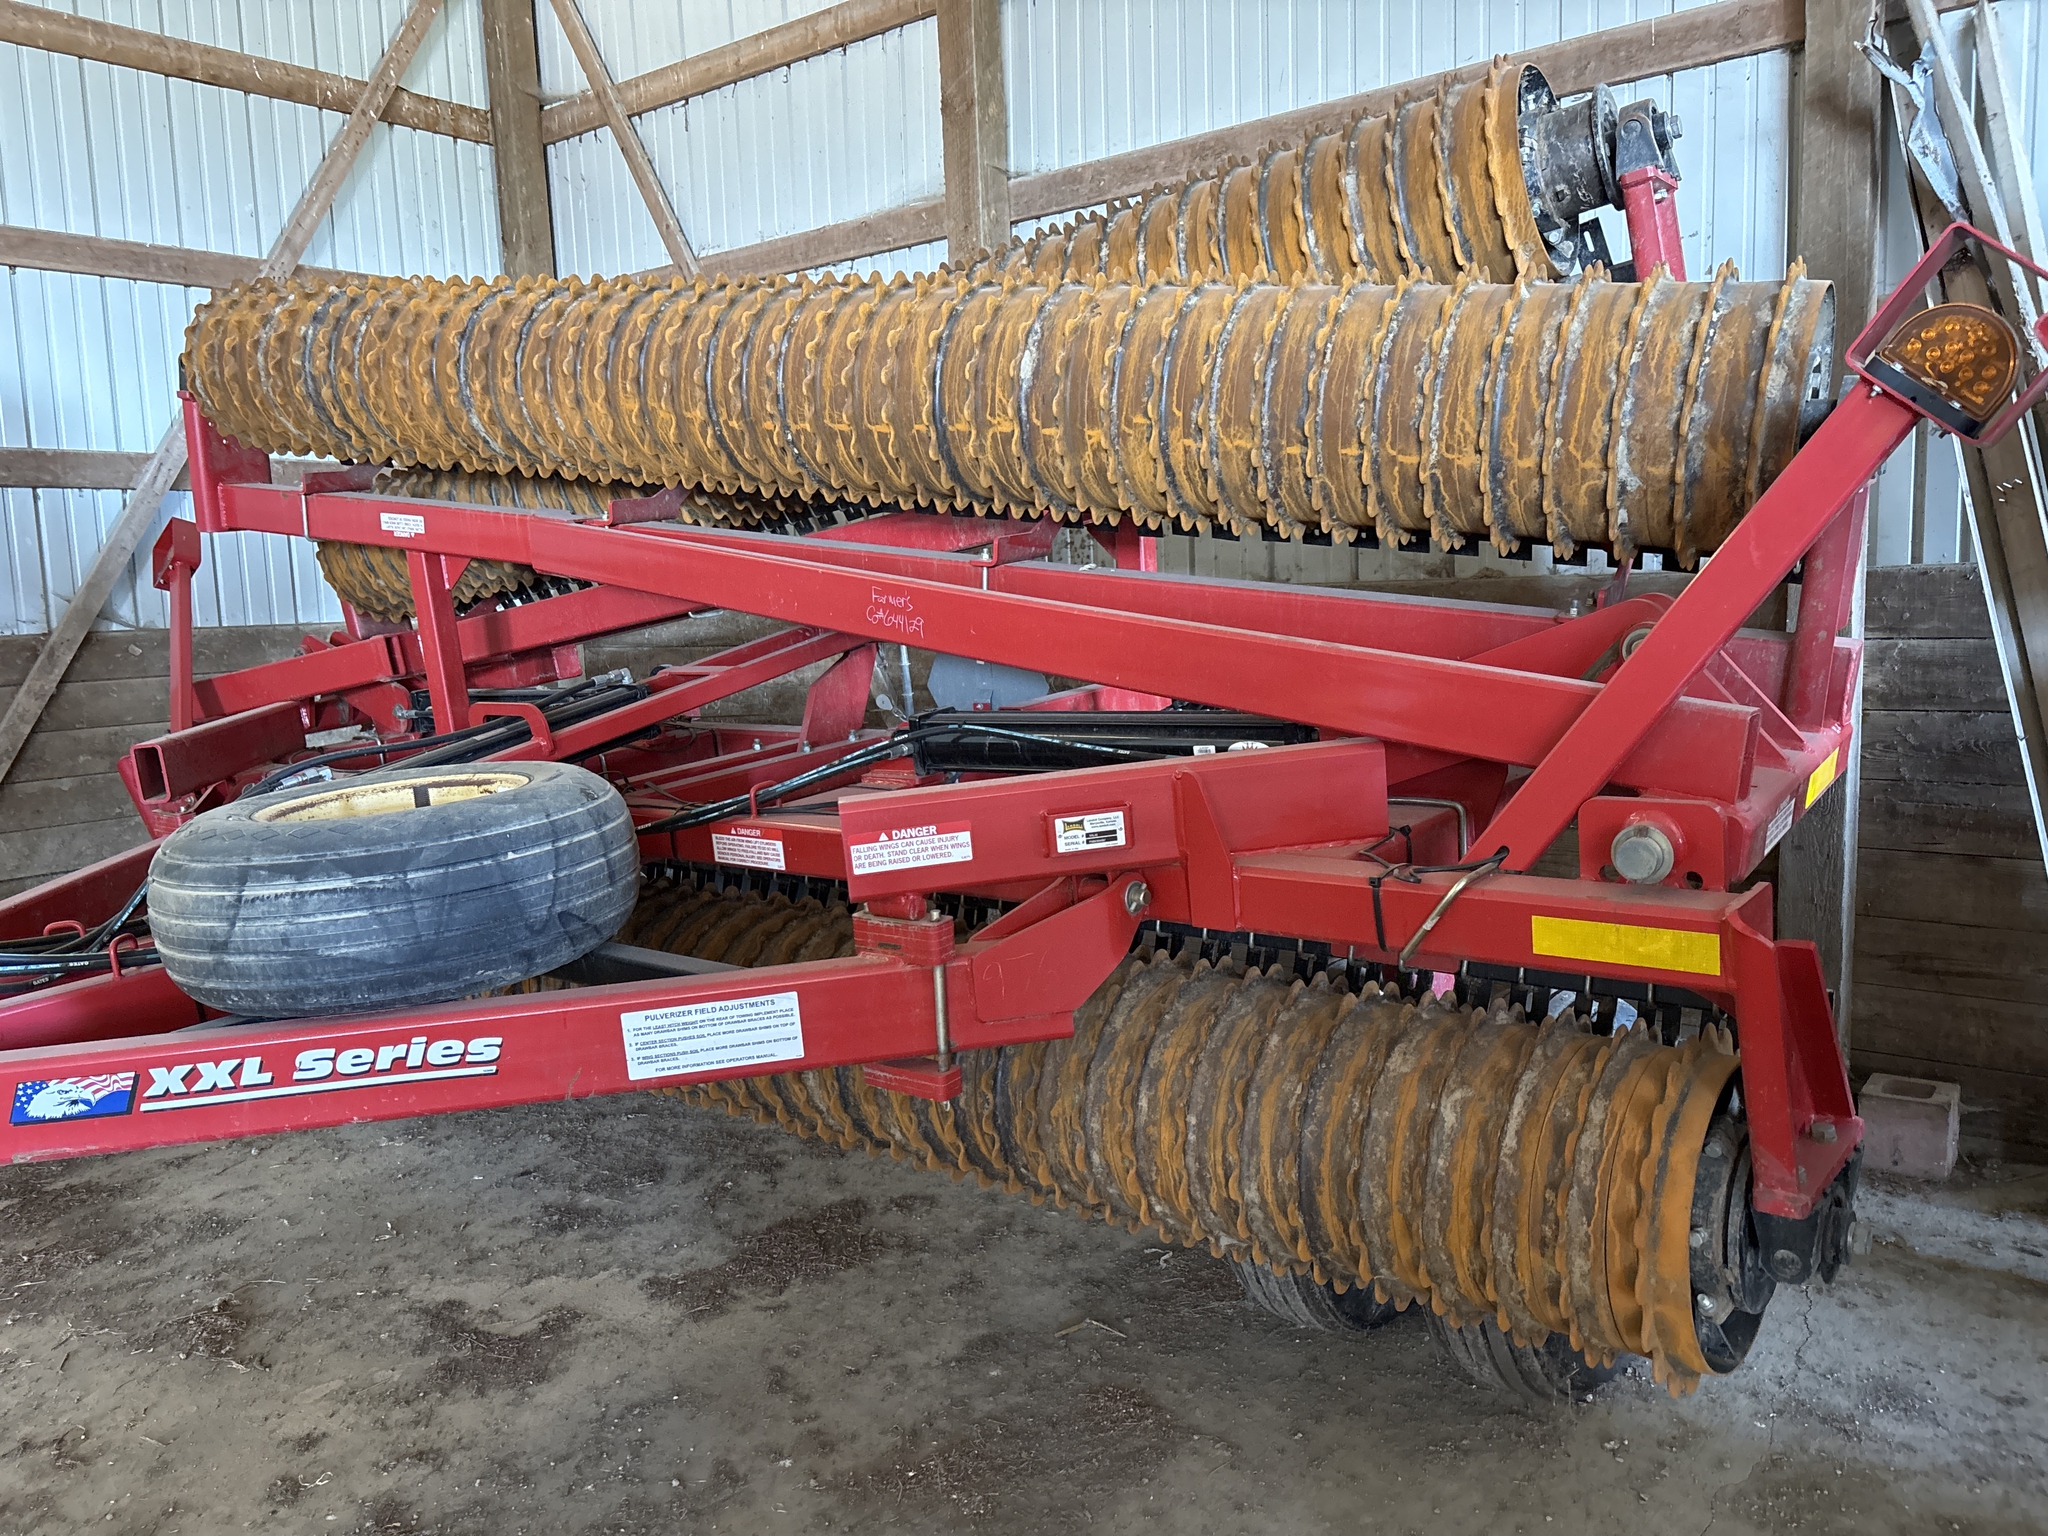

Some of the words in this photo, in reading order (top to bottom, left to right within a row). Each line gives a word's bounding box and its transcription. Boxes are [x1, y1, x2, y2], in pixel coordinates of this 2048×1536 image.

[736, 827, 761, 836] DANGER
[892, 825, 937, 840] DANGER
[852, 845, 878, 854] FALLING
[879, 843, 899, 851] WINGS
[915, 837, 935, 846] CAUSE
[937, 835, 959, 843] INJURY
[887, 850, 908, 858] STAND
[909, 847, 929, 855] CLEAR
[930, 844, 949, 852] WHEN
[950, 841, 970, 849] WINGS
[888, 856, 910, 865] RAISED
[922, 851, 954, 861] LOWERED.
[33, 977, 49, 986] GATES
[644, 1009, 693, 1022] PULVERIZER
[695, 1006, 717, 1015] FIELD
[718, 999, 775, 1012] ADJUSTMENTS
[142, 1056, 274, 1099] XXL
[292, 1036, 503, 1082] Series
[682, 1061, 714, 1069] INFORMATION
[726, 1055, 755, 1063] OPERATORS
